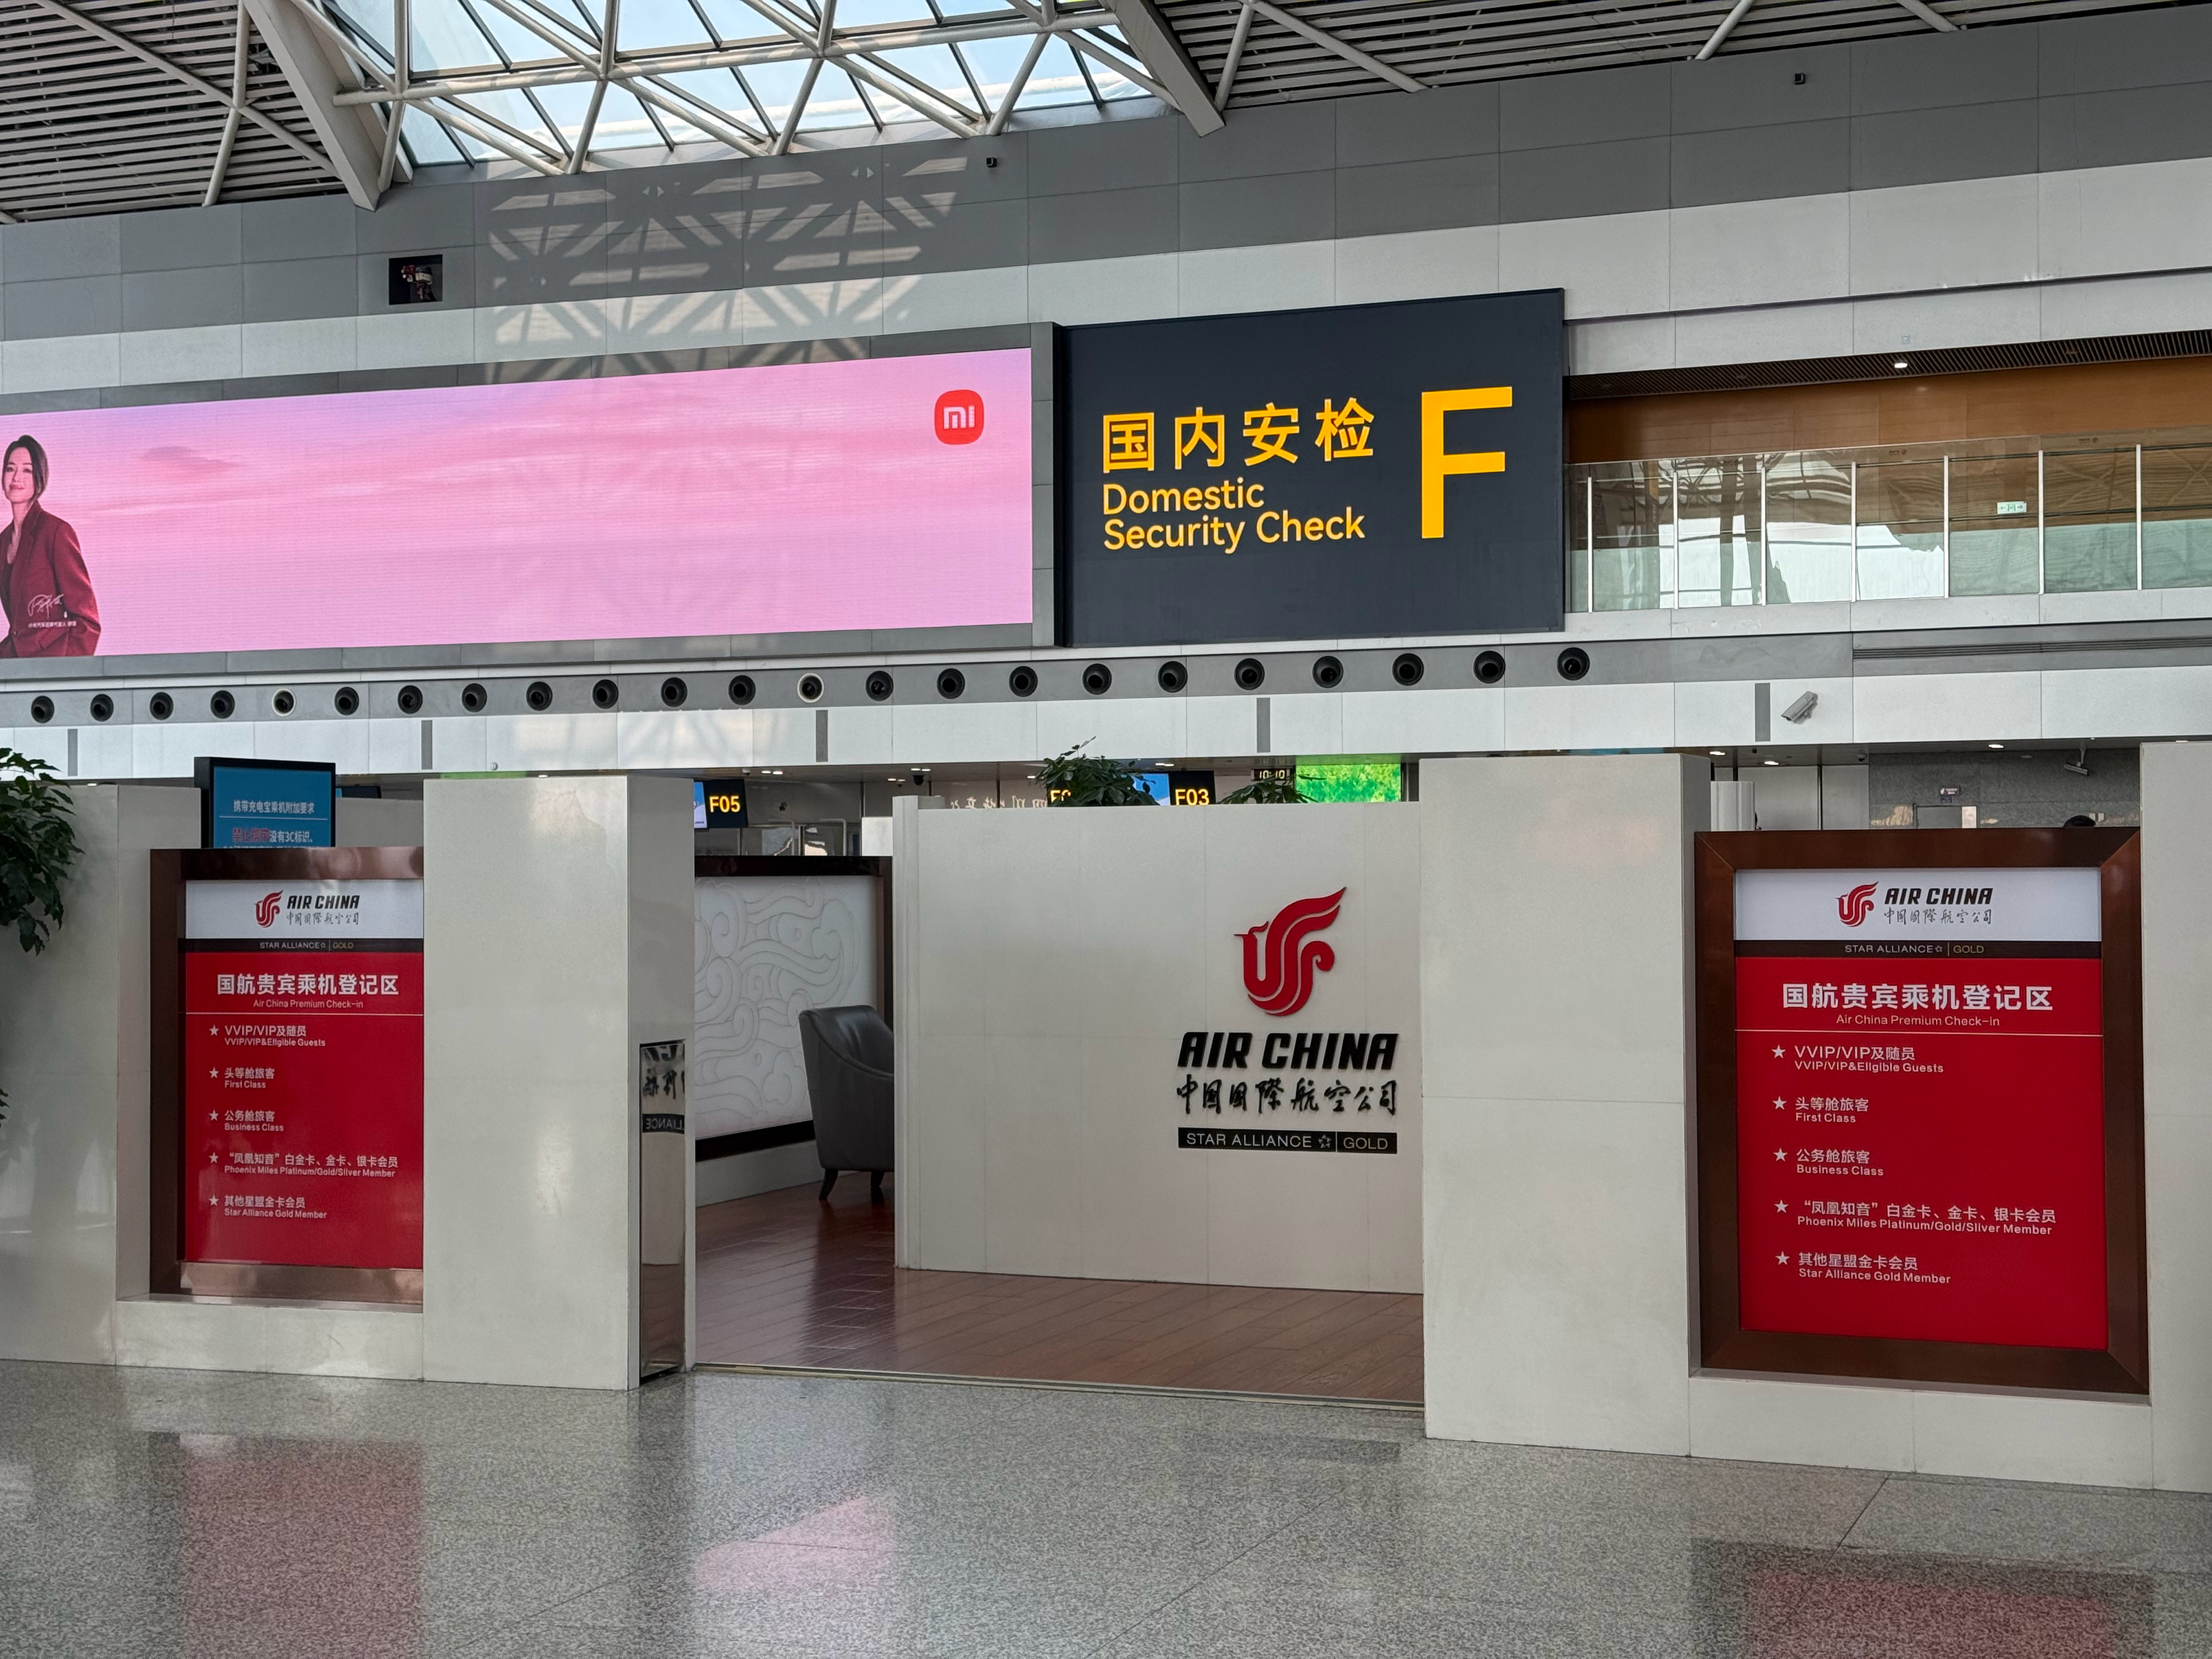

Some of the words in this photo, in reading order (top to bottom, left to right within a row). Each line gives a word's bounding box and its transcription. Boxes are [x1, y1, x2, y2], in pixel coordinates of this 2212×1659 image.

[1103, 397, 1375, 473] 国内安检
[1421, 386, 1513, 539] F
[1103, 477, 1265, 516] Domestic
[1104, 515, 1245, 555] Security
[1256, 506, 1366, 543] Check
[709, 795, 740, 812] F05
[1175, 788, 1209, 805] F03
[287, 895, 312, 909] AIR
[314, 895, 360, 909] CHINA
[1884, 888, 1922, 904] AIR
[1926, 888, 1993, 905] CHINA
[1877, 945, 1933, 953] ALLIANCE
[1954, 945, 1984, 953] GOLD
[217, 973, 399, 995] 国航贵宾乘机登记区
[266, 1000, 289, 1008] China
[290, 1000, 324, 1008] Premium
[1782, 983, 2053, 1011] 国航贵宾乘机登记区
[1836, 1014, 1852, 1024] Air
[1855, 1014, 1888, 1025] China
[1891, 1015, 1942, 1026] Premium
[224, 1025, 306, 1037] VVIP/VIP及随员
[1177, 1031, 1253, 1068] AIR
[1262, 1033, 1398, 1070] CHINA
[1795, 1046, 1915, 1060] VVIP/VIP及随员
[224, 1067, 275, 1079] 头等舱旅客
[1795, 1061, 1900, 1074] VVIP/VIP&Eligible
[1903, 1063, 1944, 1073] Guests
[244, 1080, 266, 1088] Class
[1795, 1097, 1869, 1112] 头等舱旅客
[224, 1110, 275, 1122] 公务舱旅客
[1796, 1113, 1822, 1122] First
[1824, 1113, 1857, 1122] Class
[1187, 1133, 1226, 1146] STAR
[1232, 1134, 1312, 1147] ALLIANCE
[1344, 1137, 1388, 1149] GOLD
[1796, 1148, 1870, 1164] 公务舱旅客
[257, 1166, 278, 1175] Miles
[280, 1167, 361, 1176] Platinum/Gold/Silver
[363, 1169, 395, 1177] Member
[1796, 1164, 1849, 1175] Business
[1851, 1165, 1884, 1176] Class
[224, 1195, 305, 1209] 其他星盟金卡会员
[242, 1209, 273, 1217] Alliance
[275, 1210, 293, 1218] Gold
[295, 1210, 327, 1218] Member
[1797, 1216, 1843, 1227] Phoenix
[1847, 1218, 1877, 1228] Miles
[1880, 1219, 2000, 1233] Platinum/Gold/Silver
[2004, 1224, 2052, 1235] Member
[1798, 1251, 1918, 1271] 其他星盟金卡会员
[1799, 1268, 1823, 1278] Star
[1825, 1269, 1871, 1280] Alliance
[1874, 1271, 1900, 1282] Gold
[1903, 1273, 1951, 1284] Member
